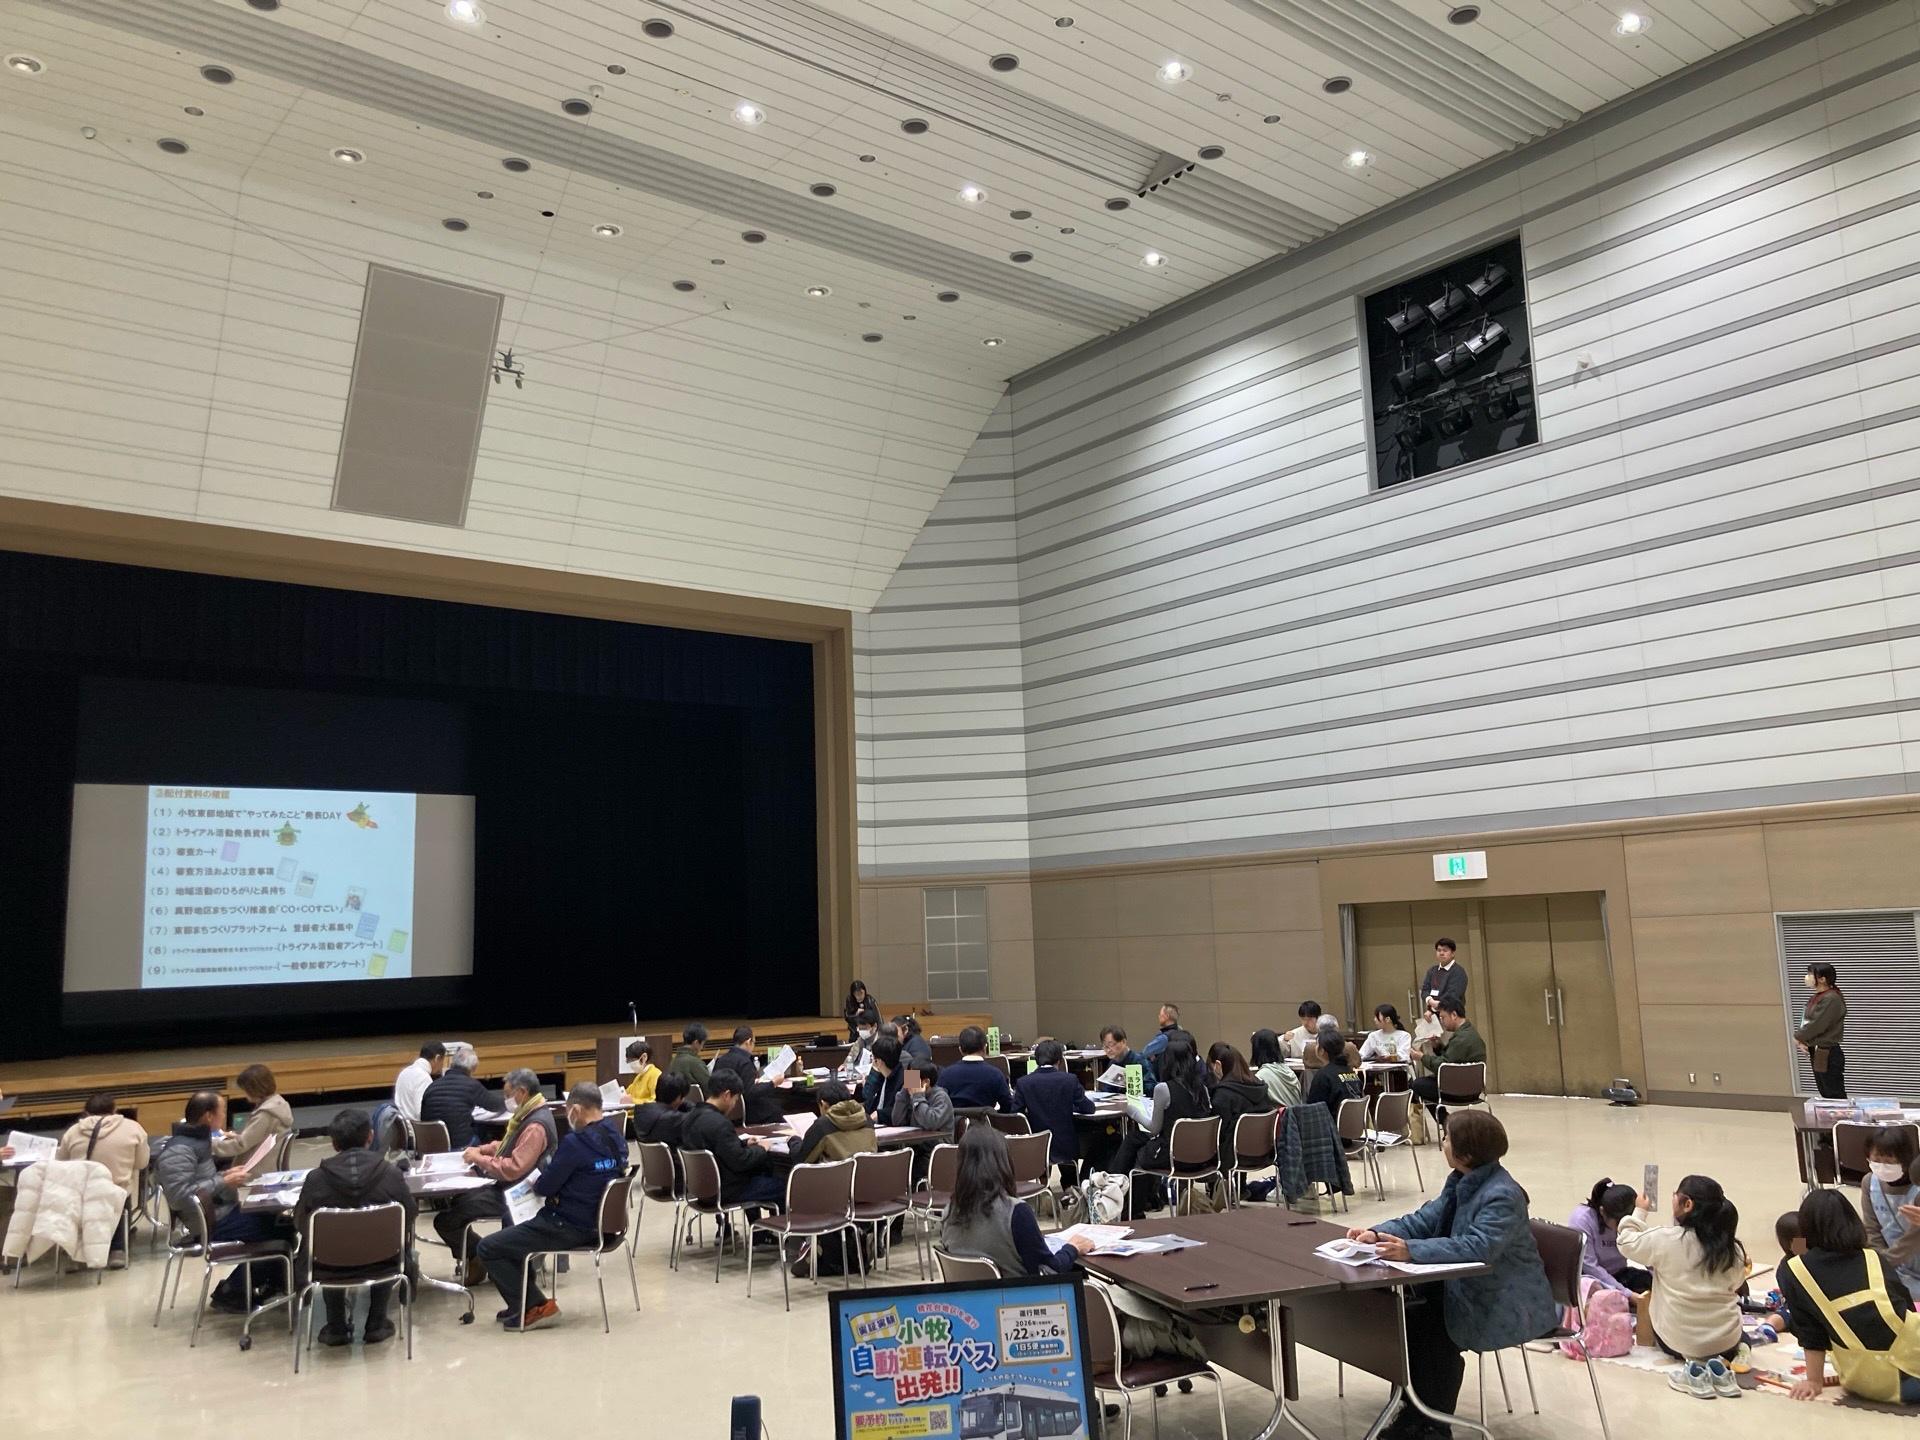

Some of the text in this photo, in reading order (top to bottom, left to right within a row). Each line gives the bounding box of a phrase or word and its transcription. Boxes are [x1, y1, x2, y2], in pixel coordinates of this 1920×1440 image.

[898, 1316, 951, 1344] 小牧
[1005, 1327, 1029, 1341] 1/22
[1041, 1325, 1059, 1338] 2/6
[852, 1339, 995, 1375] 自動運転バス
[895, 1367, 960, 1401] 出発!!
